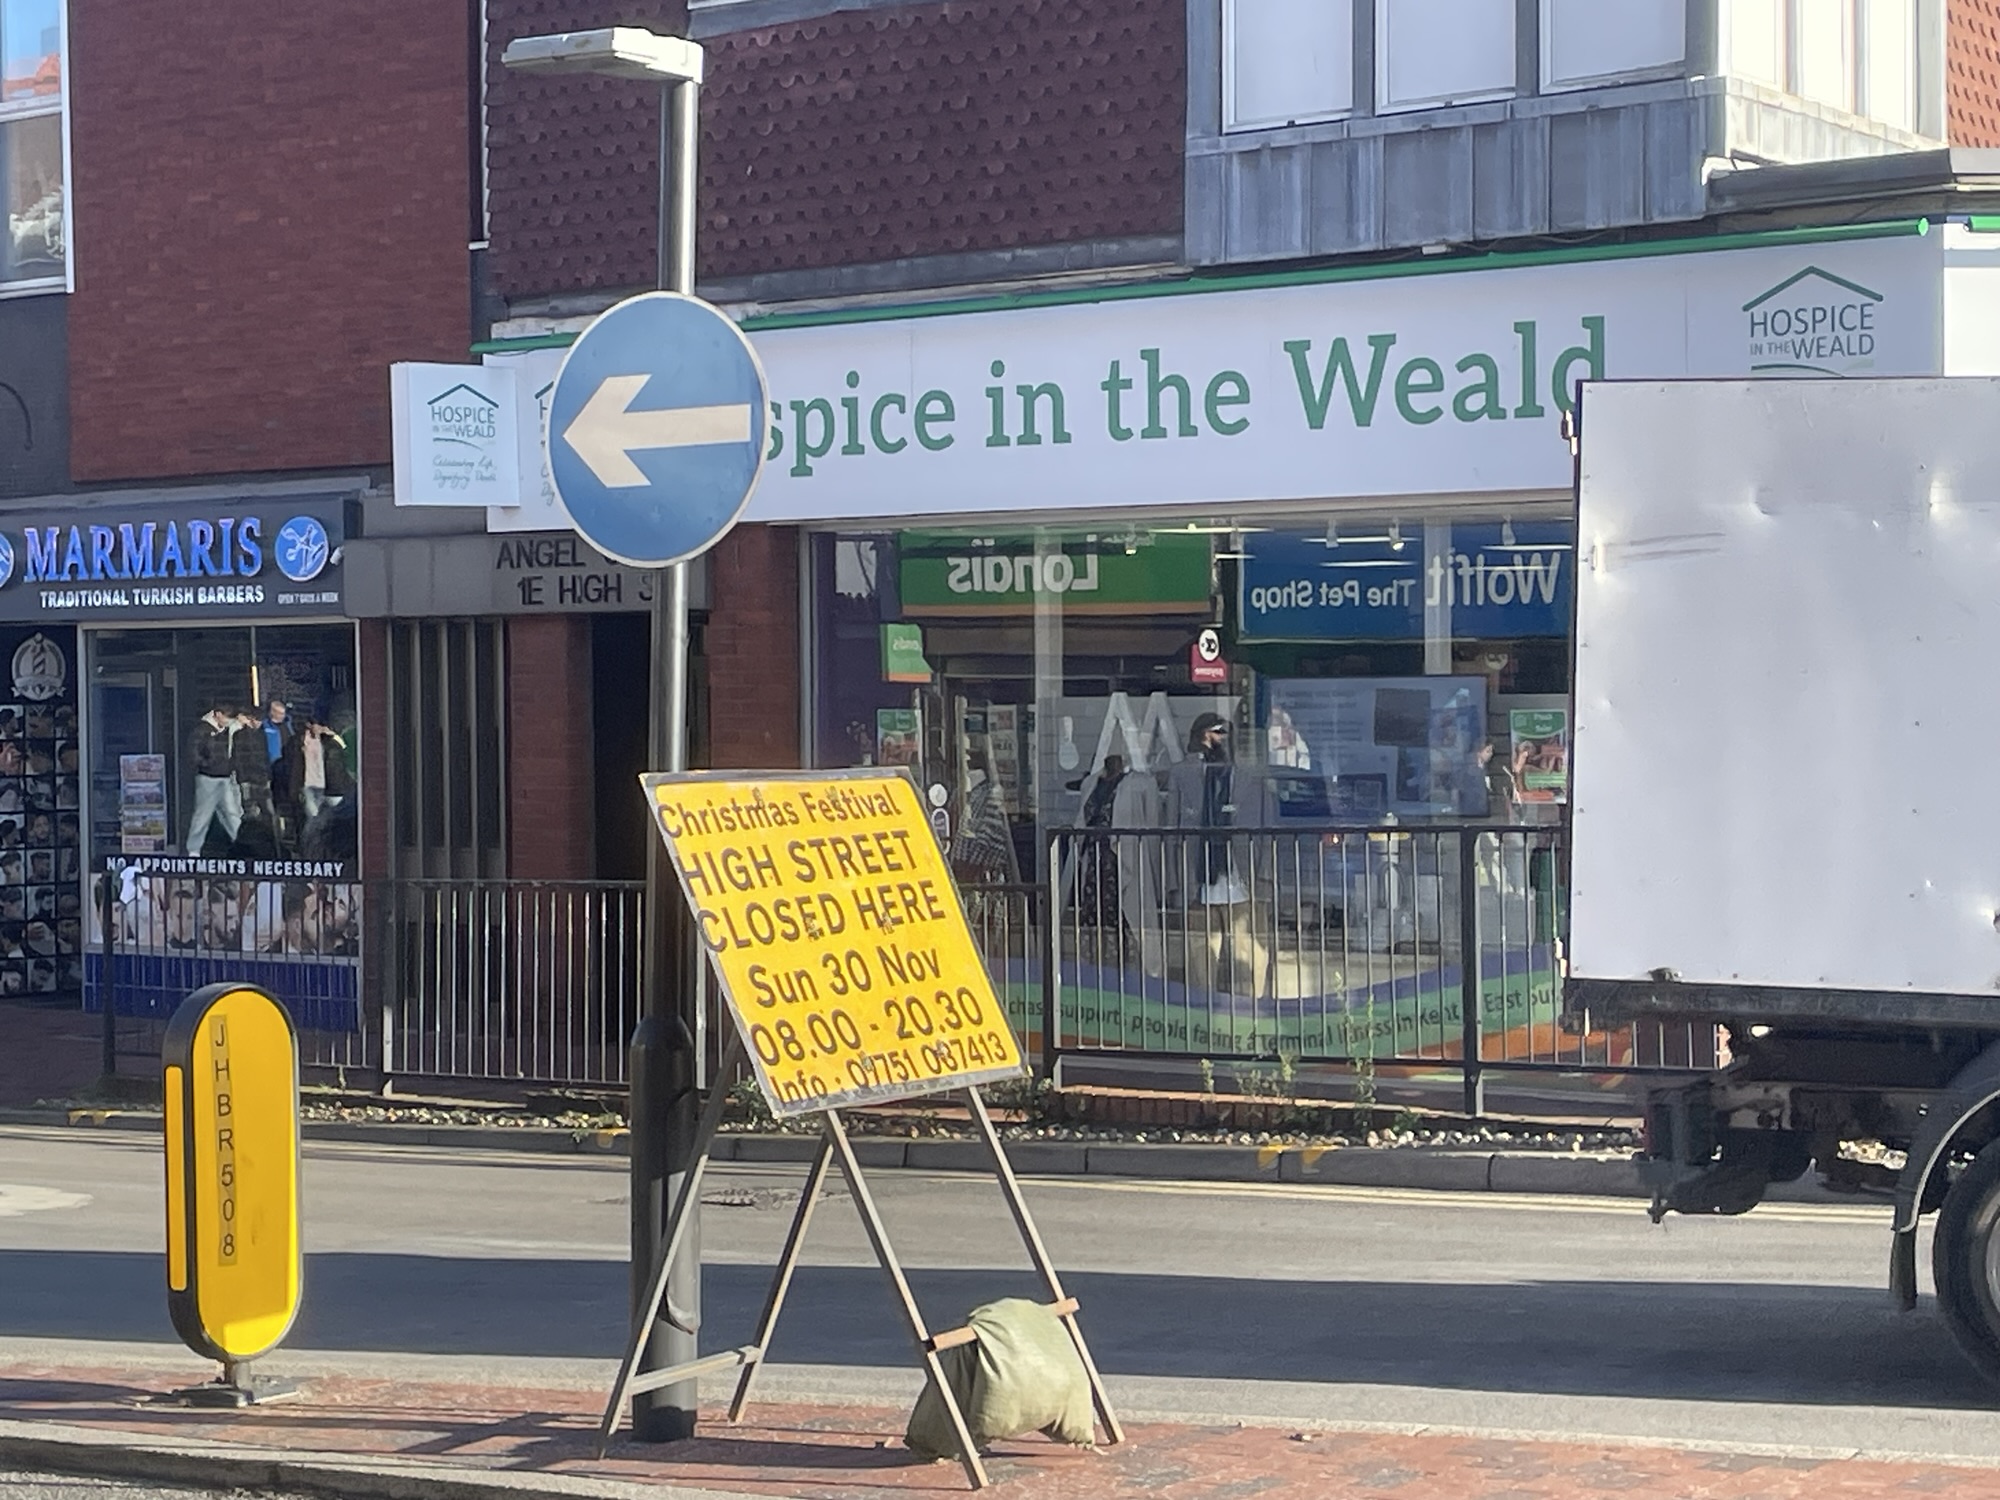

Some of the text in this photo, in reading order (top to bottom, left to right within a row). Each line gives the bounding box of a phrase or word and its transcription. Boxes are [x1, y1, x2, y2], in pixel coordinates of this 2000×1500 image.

[1749, 302, 1875, 338] HOSPICE
[1749, 333, 1875, 360] IN THE WEALD
[764, 314, 1606, 479] spice in the Weald
[431, 405, 496, 424] HOSPICE
[453, 424, 496, 439] WEALD
[22, 515, 264, 583] MARMARIS
[496, 537, 586, 570] ANGEL
[40, 584, 265, 609] TRADITIONAL TURKISH BARBERS
[516, 575, 544, 606] 1E
[559, 573, 623, 604] HIGH
[657, 784, 902, 839] Christmas Festival
[106, 856, 344, 878] NO APPOINTMENTS NECESSARY
[675, 830, 917, 898] HIGH STREET
[696, 879, 946, 953] CLOSED HERE
[749, 943, 942, 1008] Sun 30 Nov
[750, 987, 984, 1066] 08.00 - 20.30
[769, 1069, 828, 1104] Info
